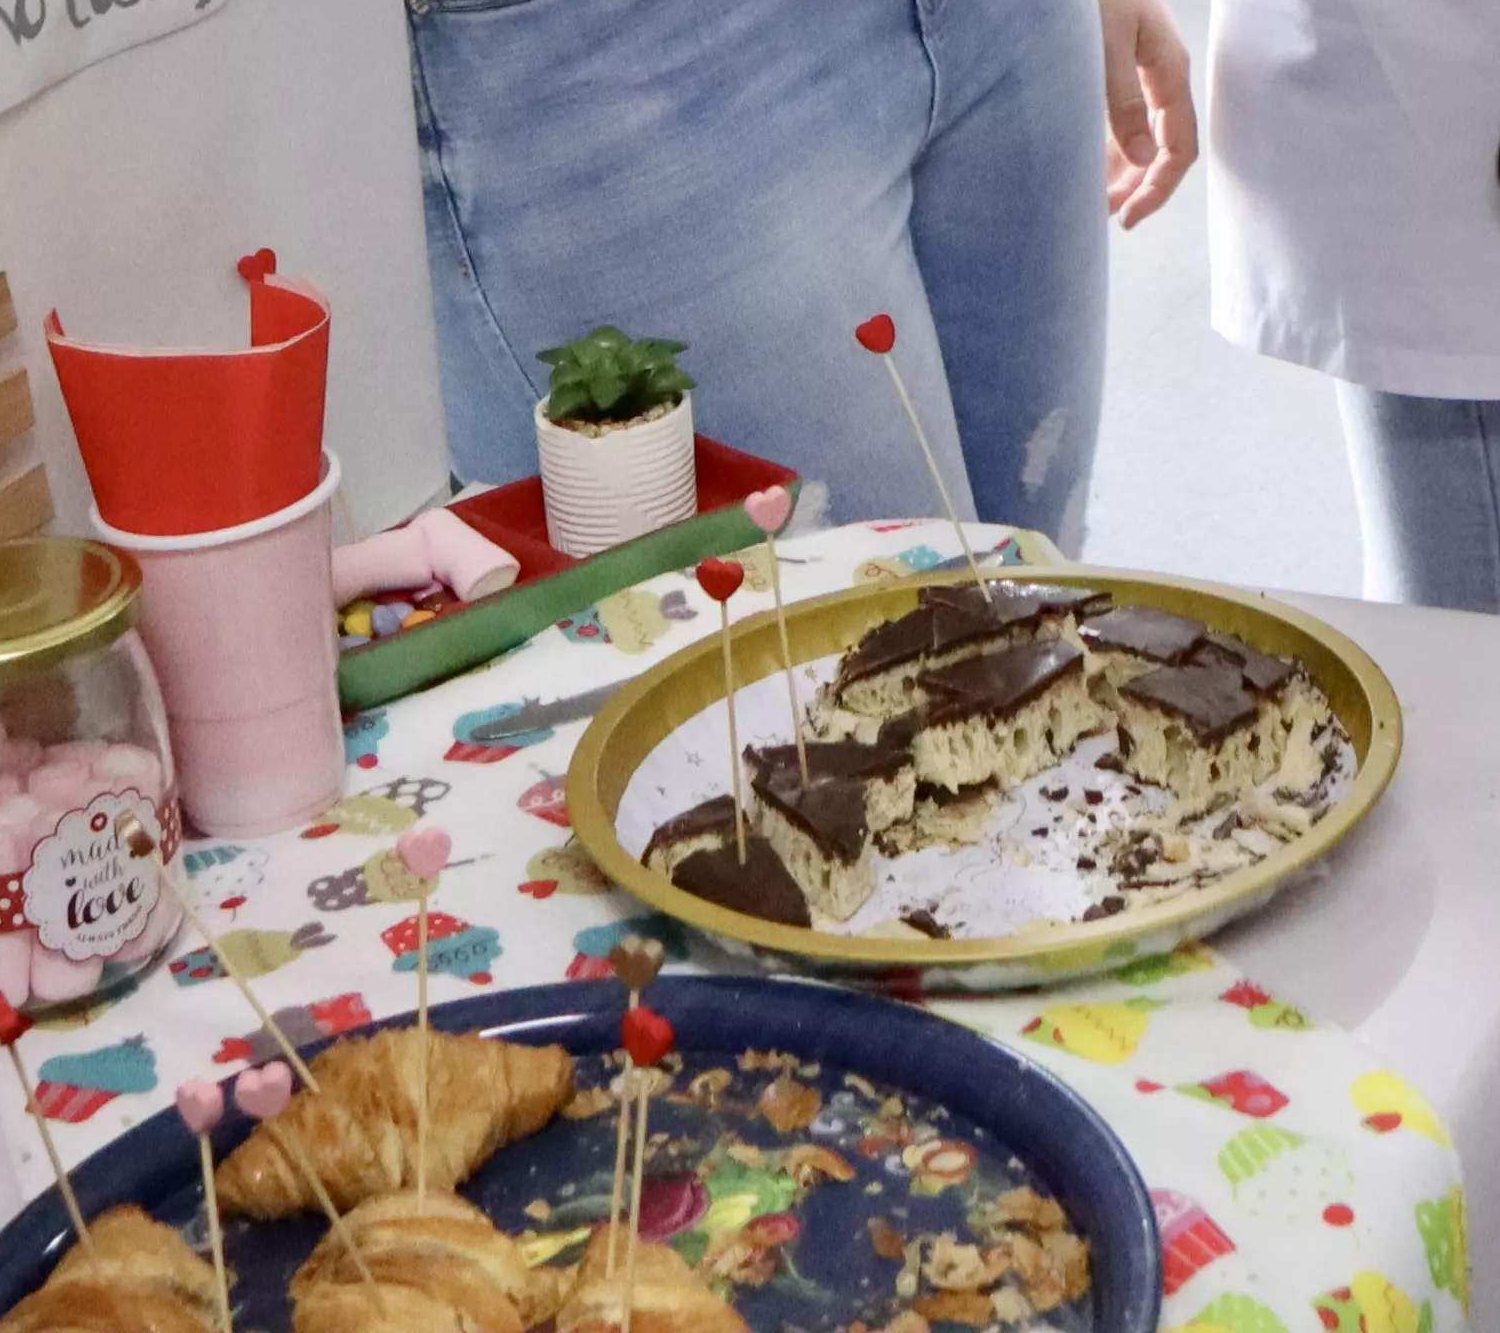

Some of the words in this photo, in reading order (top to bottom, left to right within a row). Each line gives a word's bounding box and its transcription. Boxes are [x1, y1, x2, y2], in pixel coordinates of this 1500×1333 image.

[60, 821, 126, 869] mad
[83, 856, 126, 890] with
[67, 876, 145, 930] love
